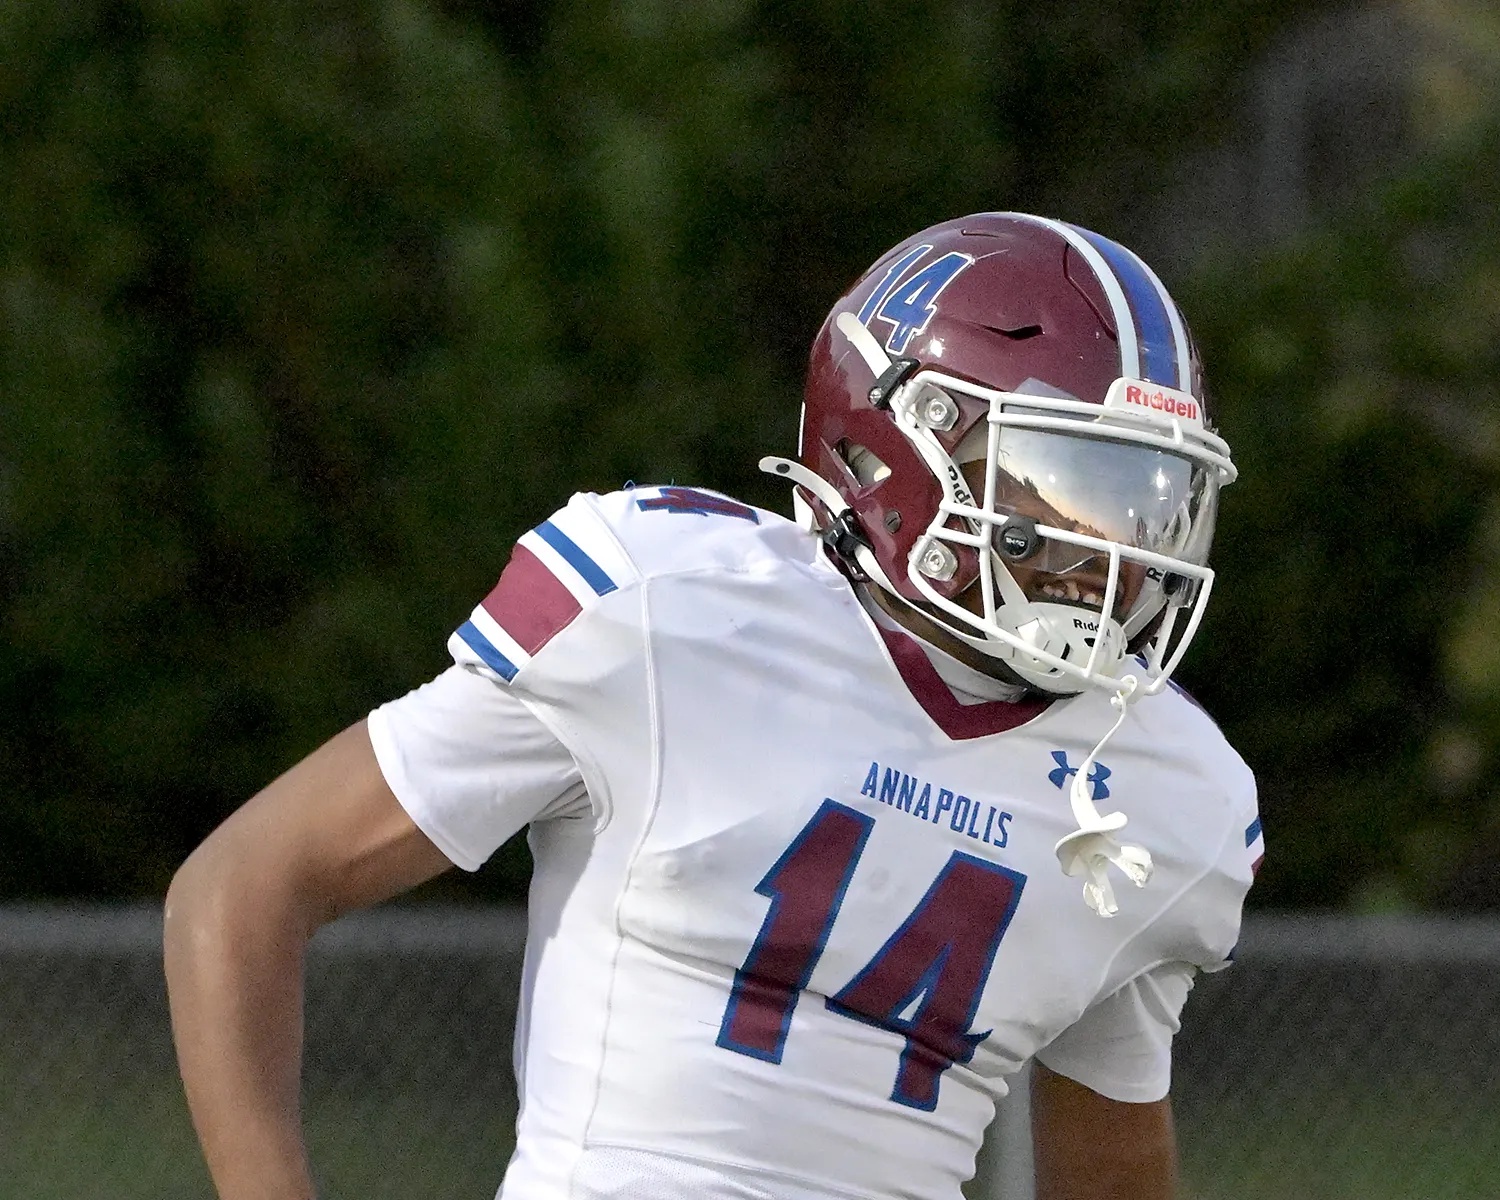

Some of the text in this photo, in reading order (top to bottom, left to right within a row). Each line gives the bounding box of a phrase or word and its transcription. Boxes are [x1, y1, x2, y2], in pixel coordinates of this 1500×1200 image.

[857, 244, 975, 355] 14
[1126, 385, 1197, 420] Riddell
[861, 762, 1013, 849] ANNAPOLIS
[715, 797, 1028, 1112] 14
